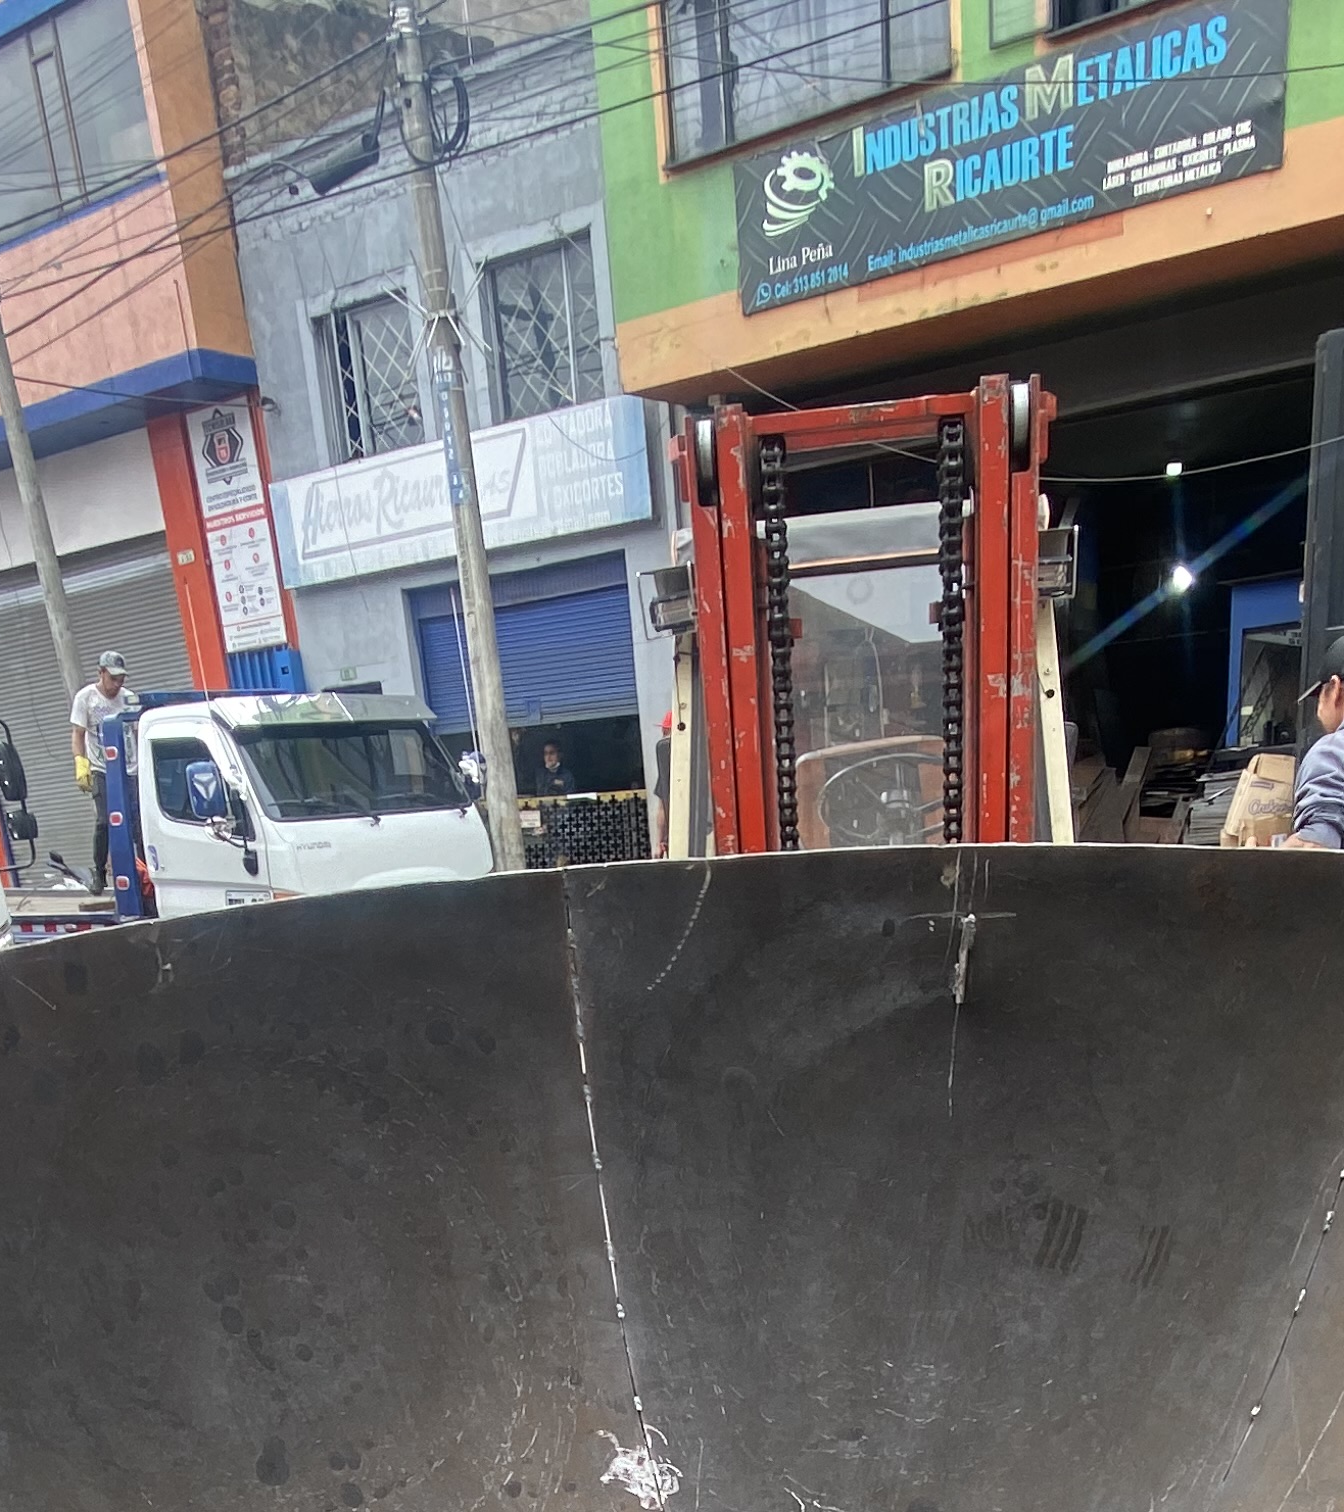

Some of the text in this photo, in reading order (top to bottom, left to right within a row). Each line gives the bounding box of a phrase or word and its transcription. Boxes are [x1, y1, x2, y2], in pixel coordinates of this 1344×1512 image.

[853, 16, 1228, 177] INDUSTRIAS METALICAS
[923, 124, 1074, 213] RICAURTE
[768, 242, 834, 276] Lina Peña
[535, 402, 613, 445] COTADORA
[374, 466, 453, 536] Ricaur
